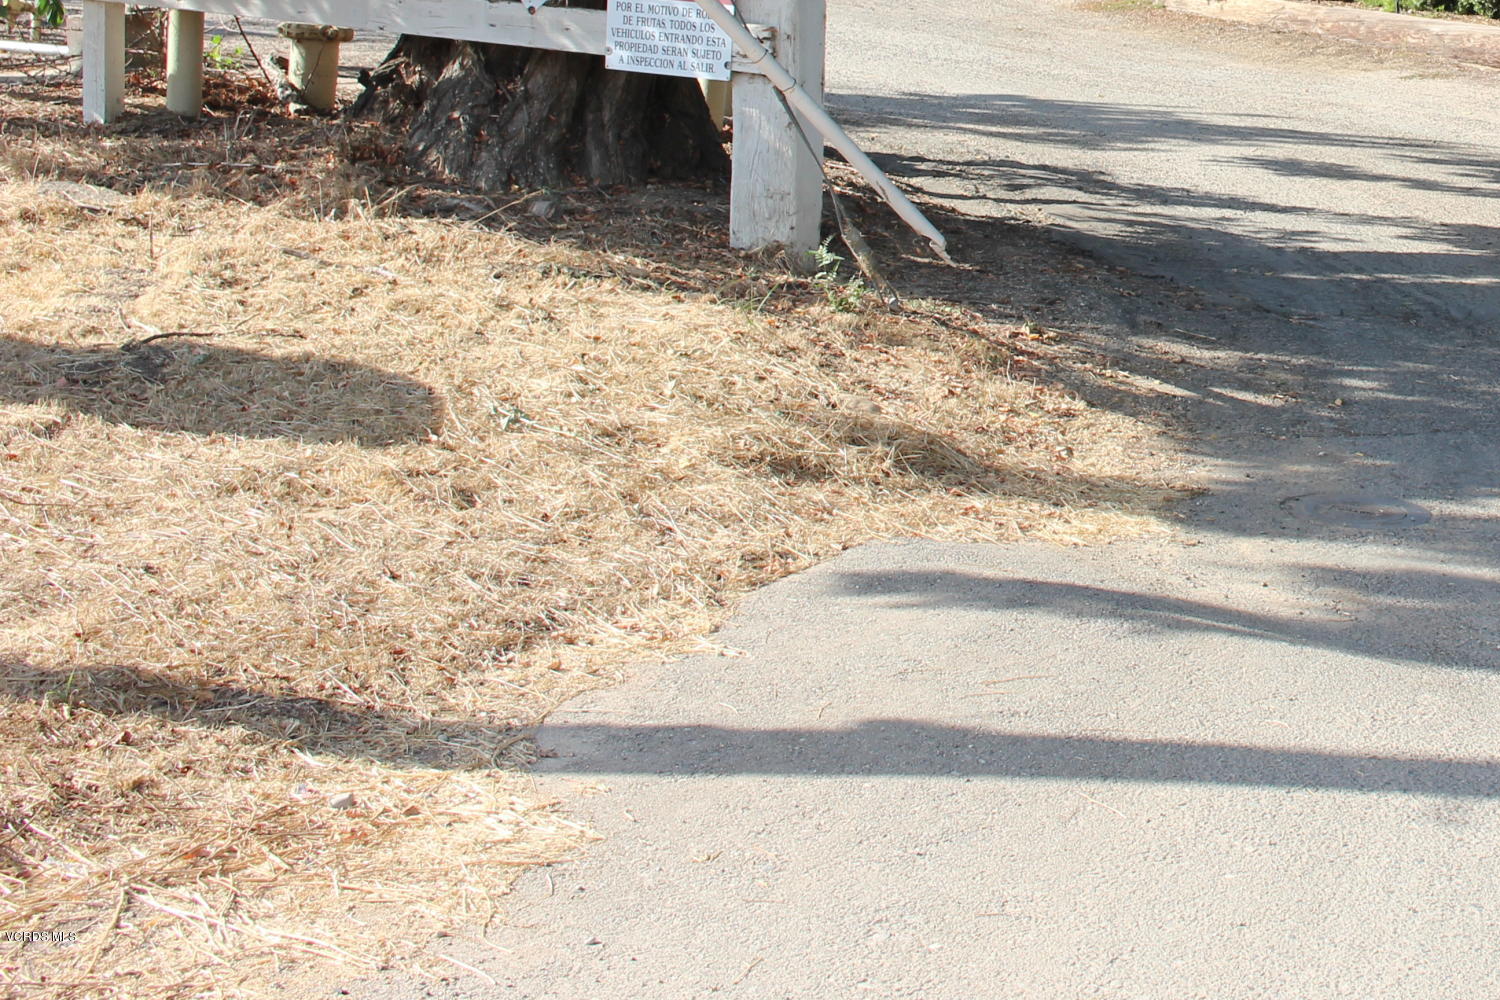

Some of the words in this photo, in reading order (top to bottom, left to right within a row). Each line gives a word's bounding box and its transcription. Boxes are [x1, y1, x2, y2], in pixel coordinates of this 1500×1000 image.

[616, 1, 632, 12] POR
[635, 2, 645, 13] EL
[648, 4, 679, 17] MOTIVO
[681, 7, 693, 18] DE
[696, 8, 711, 20] RO
[623, 14, 634, 25] DE
[670, 19, 697, 32] TODOS
[700, 22, 716, 33] LOS
[611, 27, 656, 41] VEHICULOS
[659, 32, 704, 45] ENTRANDO
[706, 36, 727, 48] ESTA
[614, 40, 659, 55] PROPIEDAD
[661, 45, 688, 57] SERAN
[691, 48, 722, 60] SUJETO
[618, 54, 625, 64] A
[627, 55, 674, 69] INSPECCION
[677, 60, 688, 71] AL
